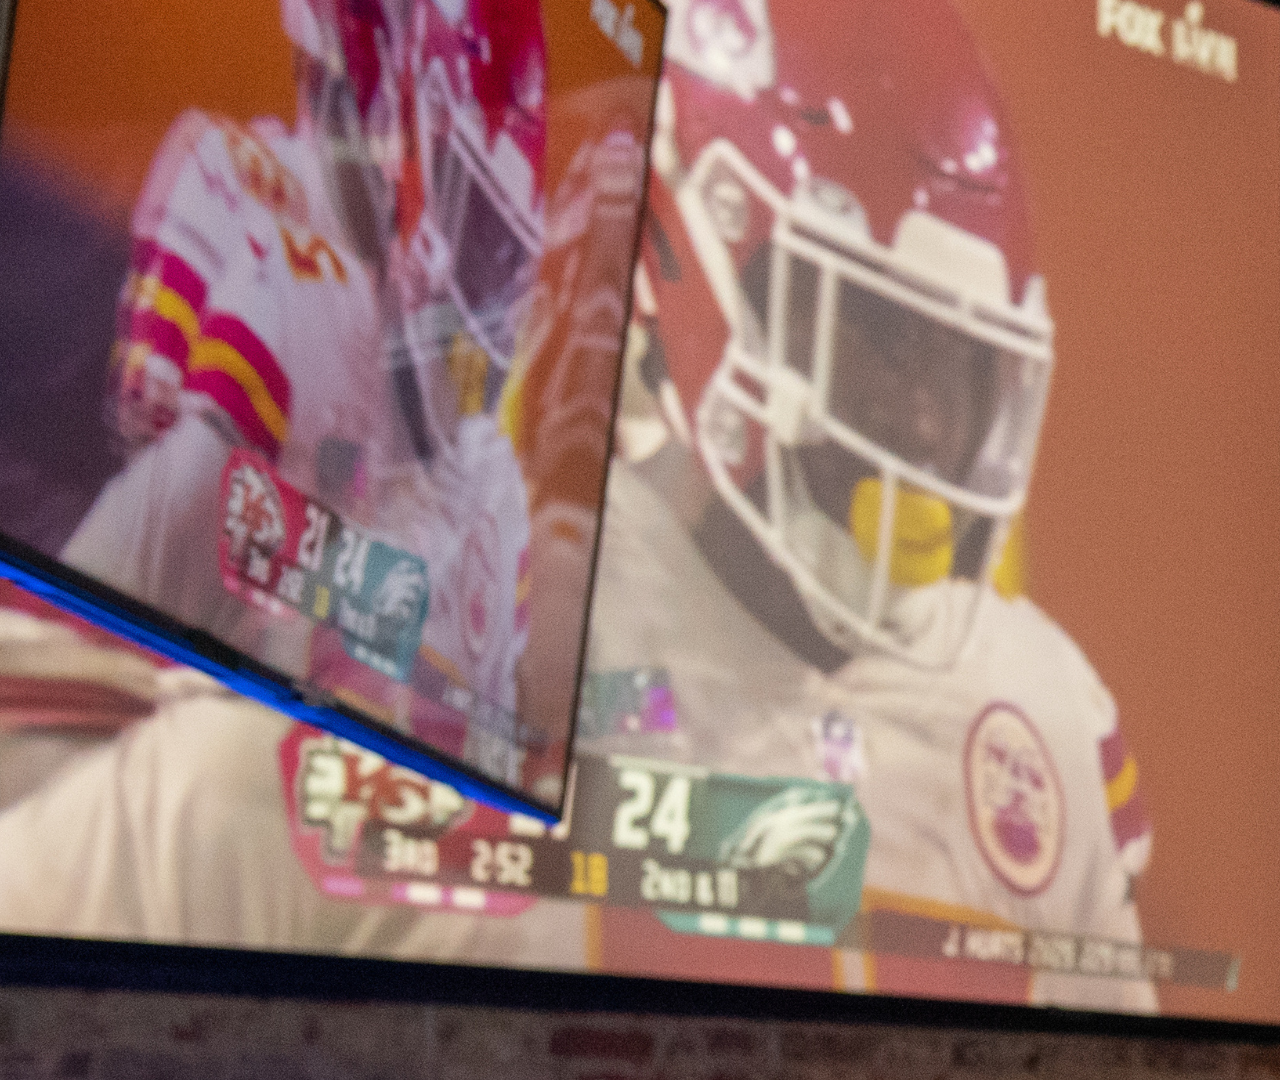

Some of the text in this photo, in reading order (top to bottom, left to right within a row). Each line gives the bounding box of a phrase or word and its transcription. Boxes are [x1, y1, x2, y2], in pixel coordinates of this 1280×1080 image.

[1097, 0, 1165, 57] FOX
[332, 527, 370, 597] 24
[612, 768, 692, 854] 24
